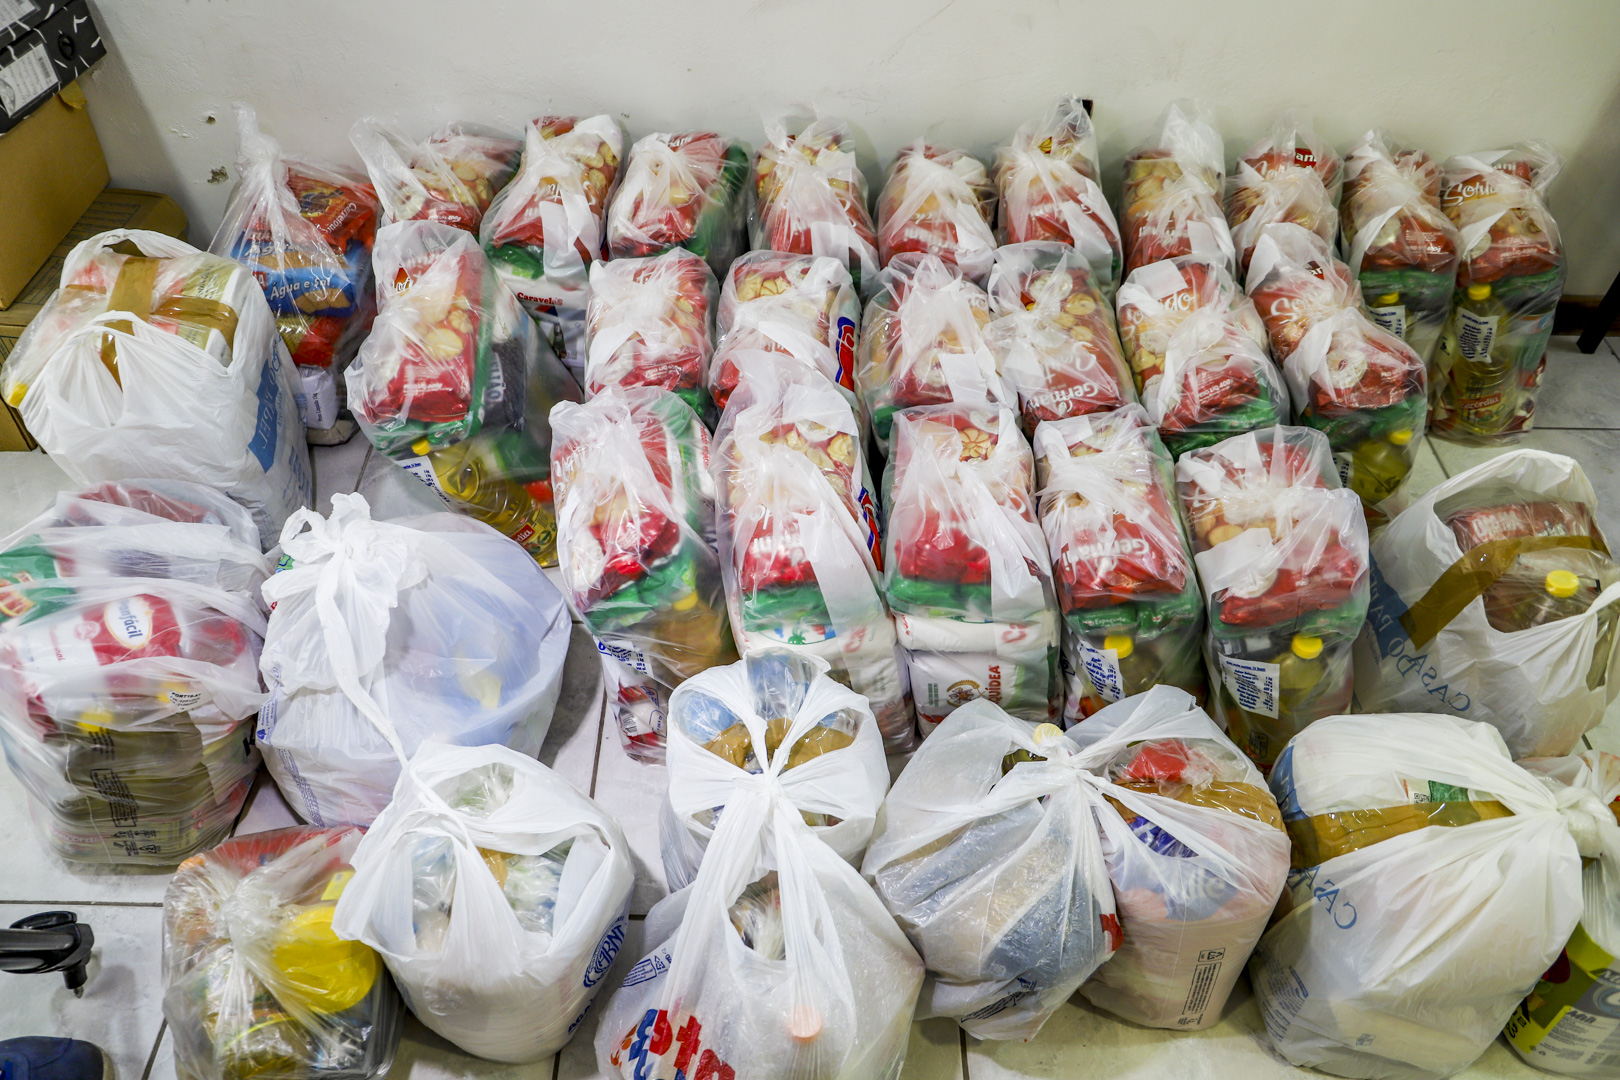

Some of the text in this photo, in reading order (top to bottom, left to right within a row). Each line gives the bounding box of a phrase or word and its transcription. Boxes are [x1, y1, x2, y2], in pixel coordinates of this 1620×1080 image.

[327, 202, 357, 233] Carrefour
[271, 282, 300, 300] Água
[303, 280, 311, 288] e
[988, 665, 1001, 703] QUÍDEA
